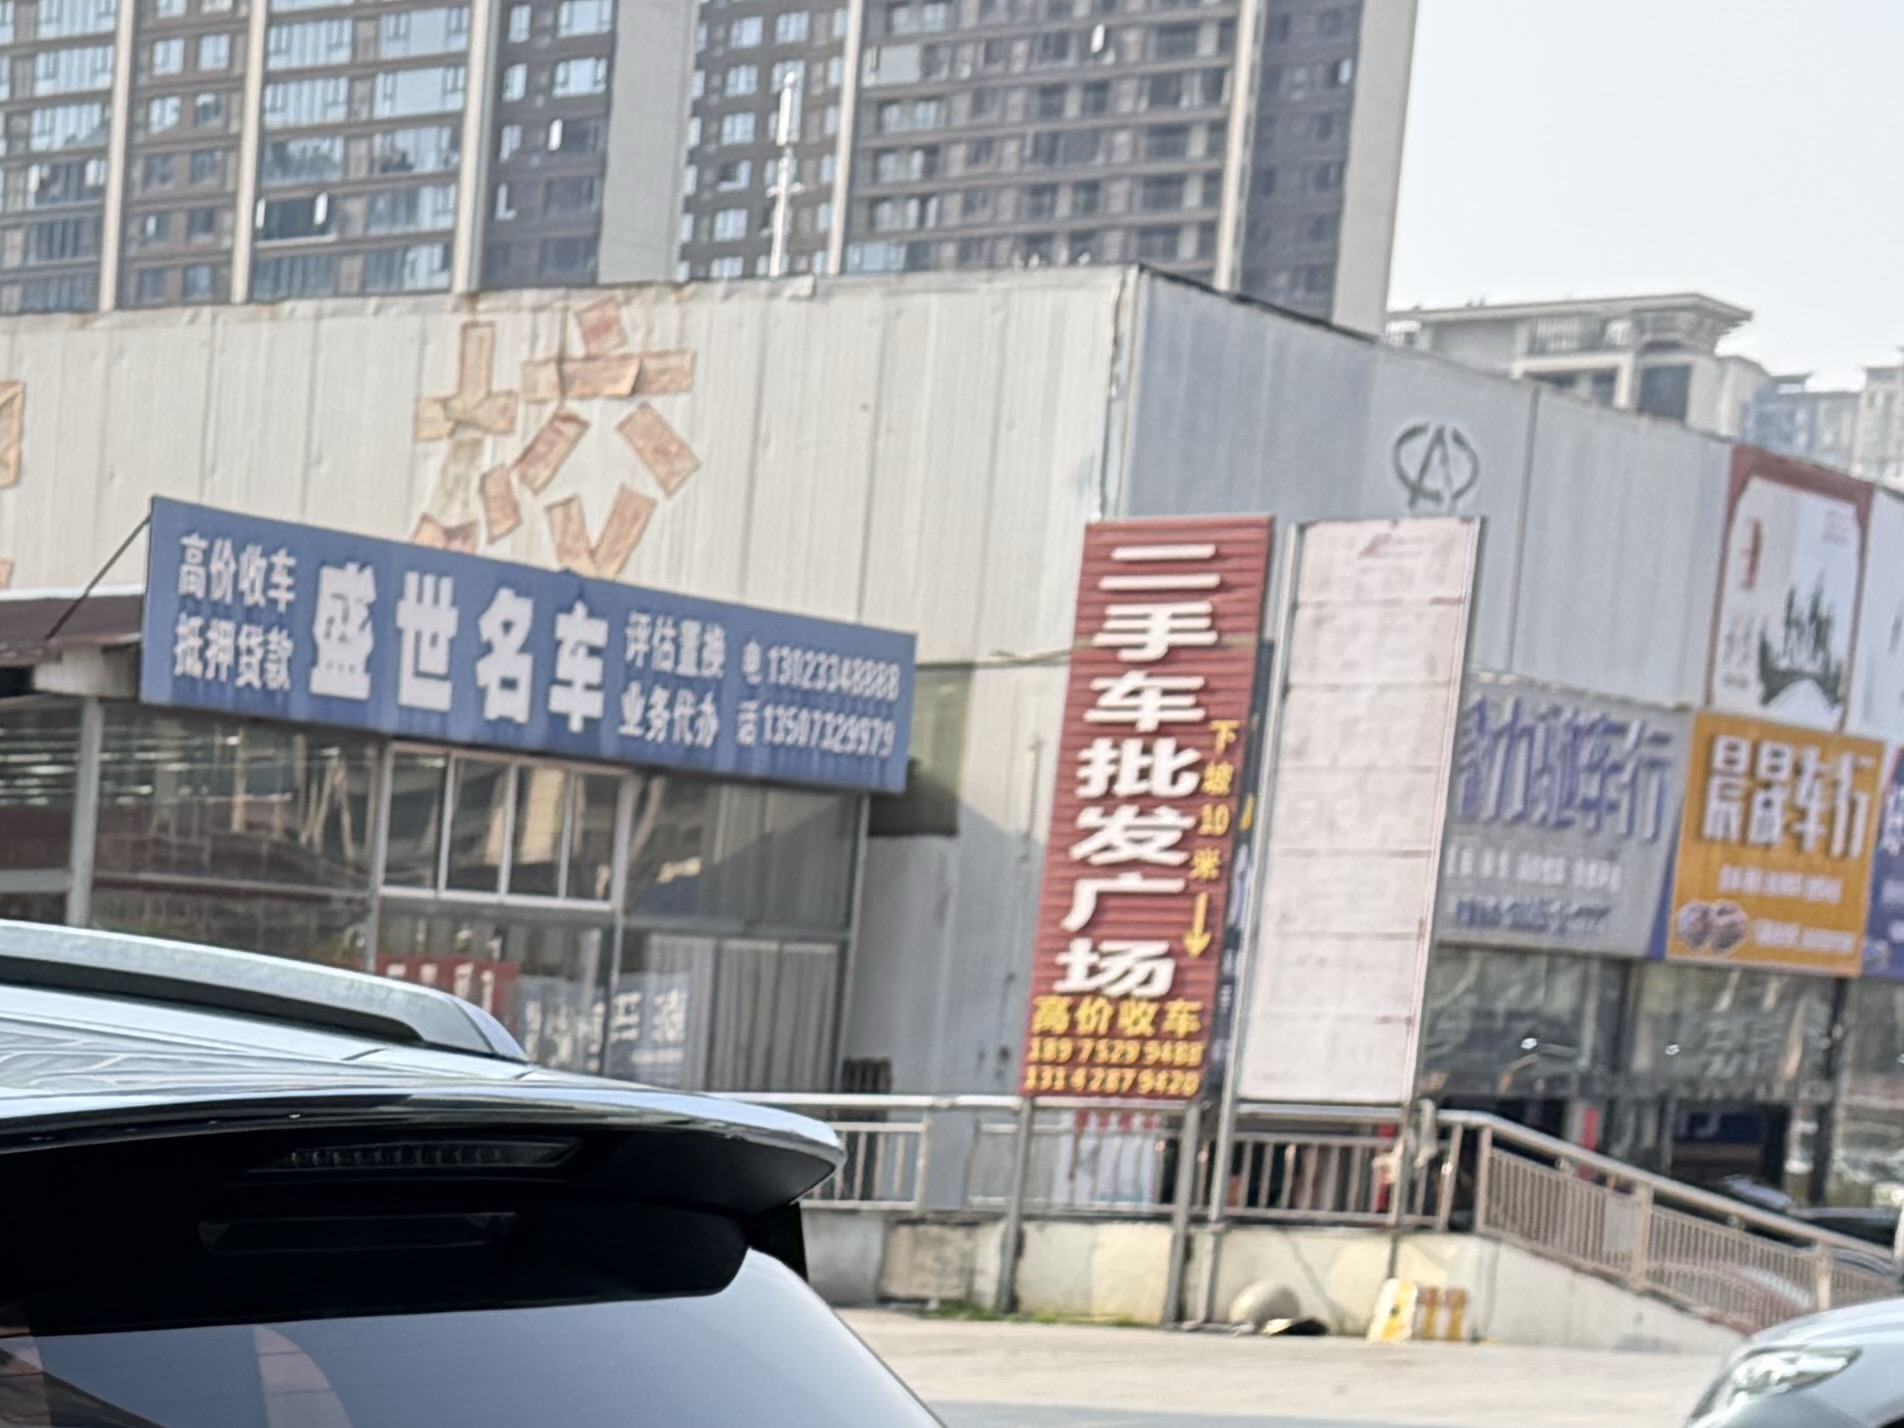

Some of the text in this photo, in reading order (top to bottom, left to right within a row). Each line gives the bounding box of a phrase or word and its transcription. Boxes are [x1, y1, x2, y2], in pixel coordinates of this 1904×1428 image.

[177, 532, 297, 612] 高价收车
[173, 612, 293, 692] 抵押贷款
[309, 560, 610, 735] 盛世名车
[1053, 543, 1220, 1000] 二手车批发广场
[1031, 994, 1204, 1039] 高价收车
